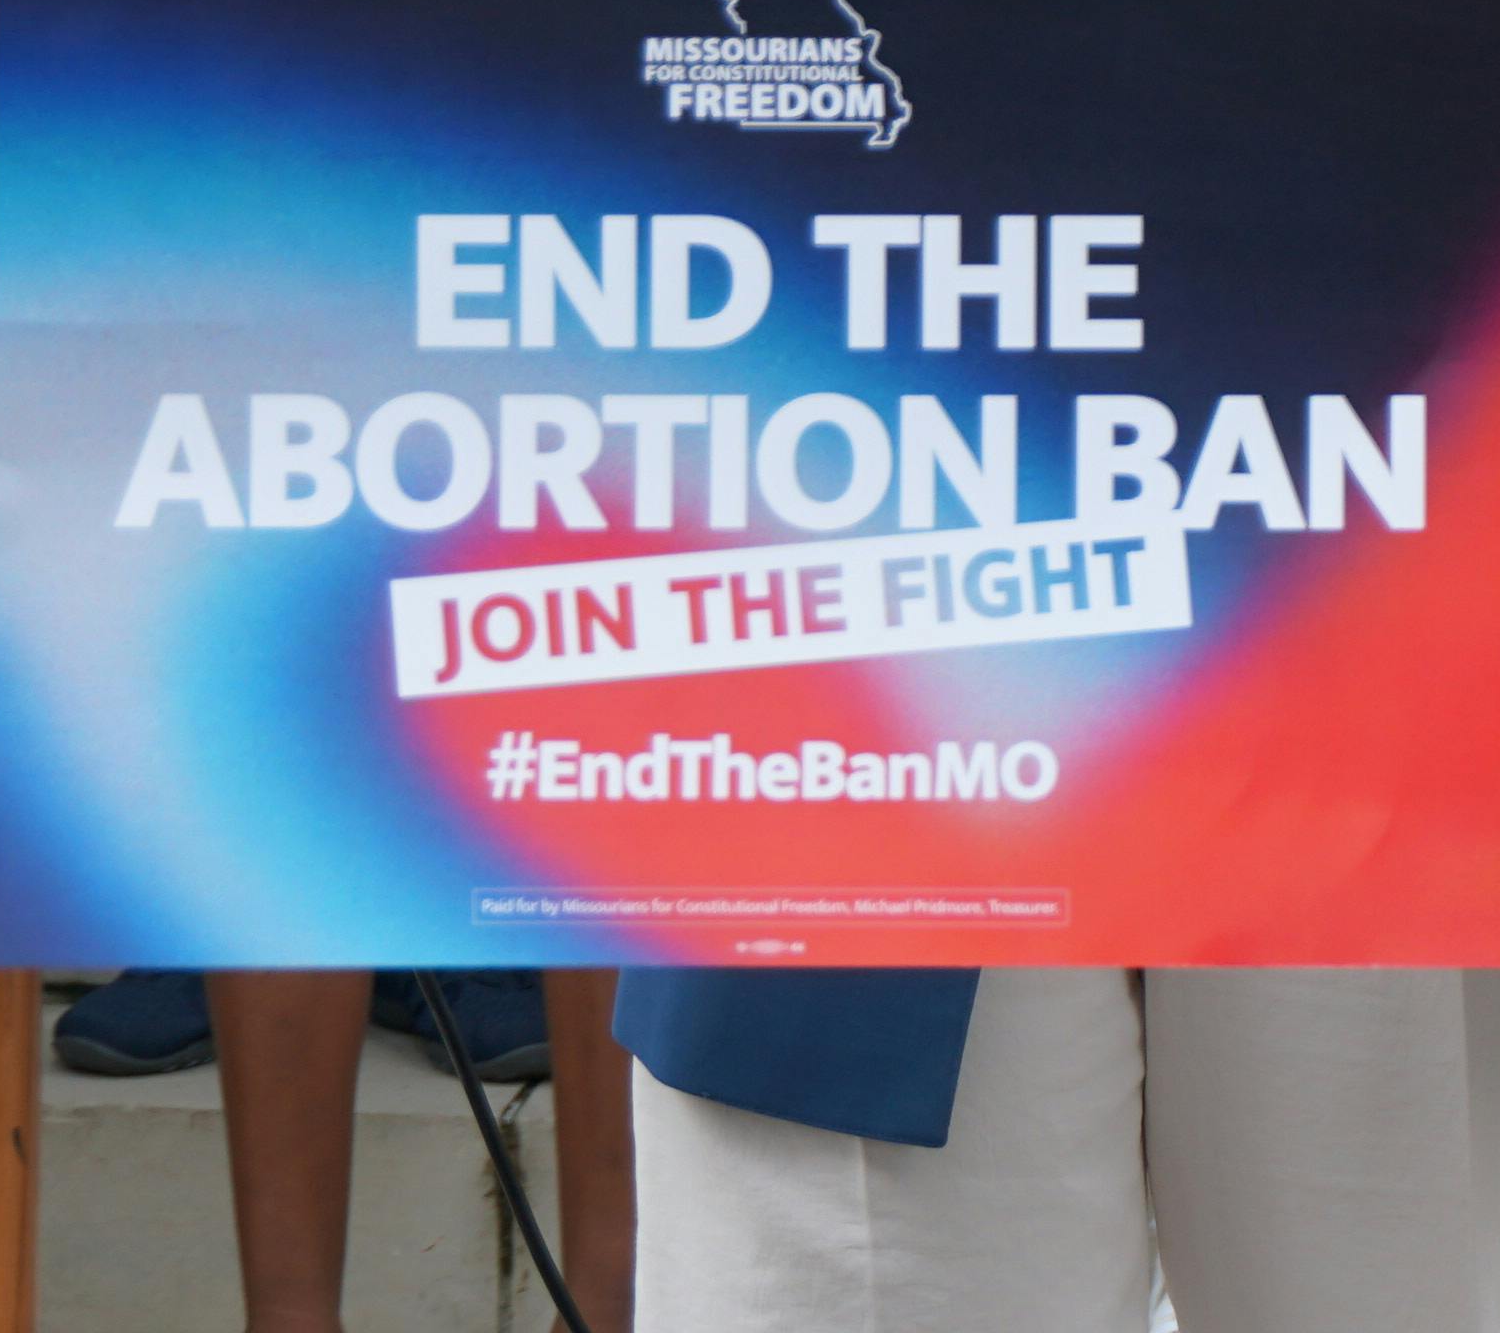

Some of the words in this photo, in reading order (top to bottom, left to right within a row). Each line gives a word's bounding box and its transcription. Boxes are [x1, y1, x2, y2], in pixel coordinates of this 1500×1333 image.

[644, 36, 864, 63] MISSOURIANS
[644, 64, 686, 82] FOR
[688, 64, 864, 82] CONSTITUTIONAL
[668, 82, 886, 119] FREEDOM
[416, 213, 773, 350] END
[813, 213, 1145, 350] THE
[114, 390, 1019, 532] ABORTION
[1074, 392, 1426, 530] BAN
[434, 581, 638, 684] JOIN
[668, 564, 847, 646] THE
[881, 536, 1146, 629] FIGHT
[486, 732, 1058, 802] #EndTheBanMO
[481, 896, 513, 914] Paid
[516, 896, 537, 913] for
[540, 896, 559, 918] by
[562, 897, 648, 914] Missourians
[651, 896, 673, 914] for
[676, 897, 779, 914] Constitutional
[854, 897, 911, 914] Michael
